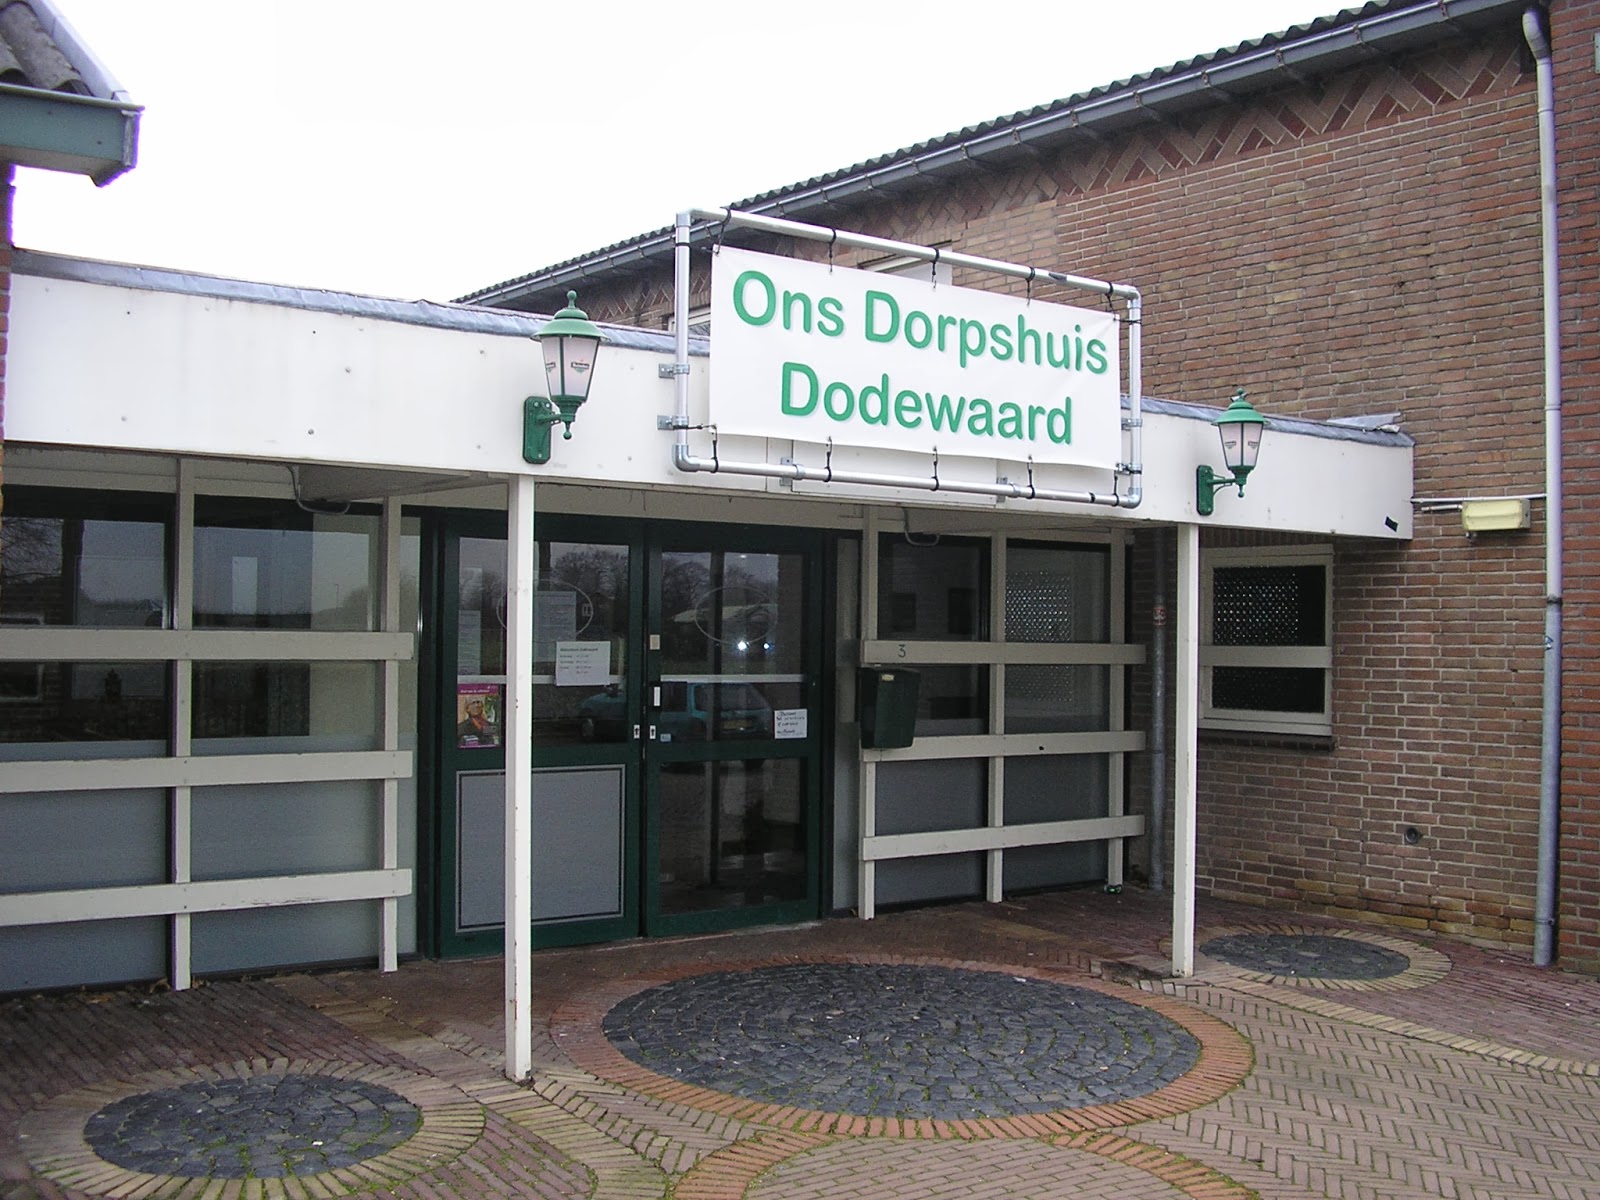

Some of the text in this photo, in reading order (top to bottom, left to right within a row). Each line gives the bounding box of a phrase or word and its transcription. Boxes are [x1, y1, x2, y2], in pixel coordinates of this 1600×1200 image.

[732, 270, 1109, 375] Ons Dorpshuis
[780, 361, 1073, 445] Dodewaard
[897, 643, 907, 658] 3
